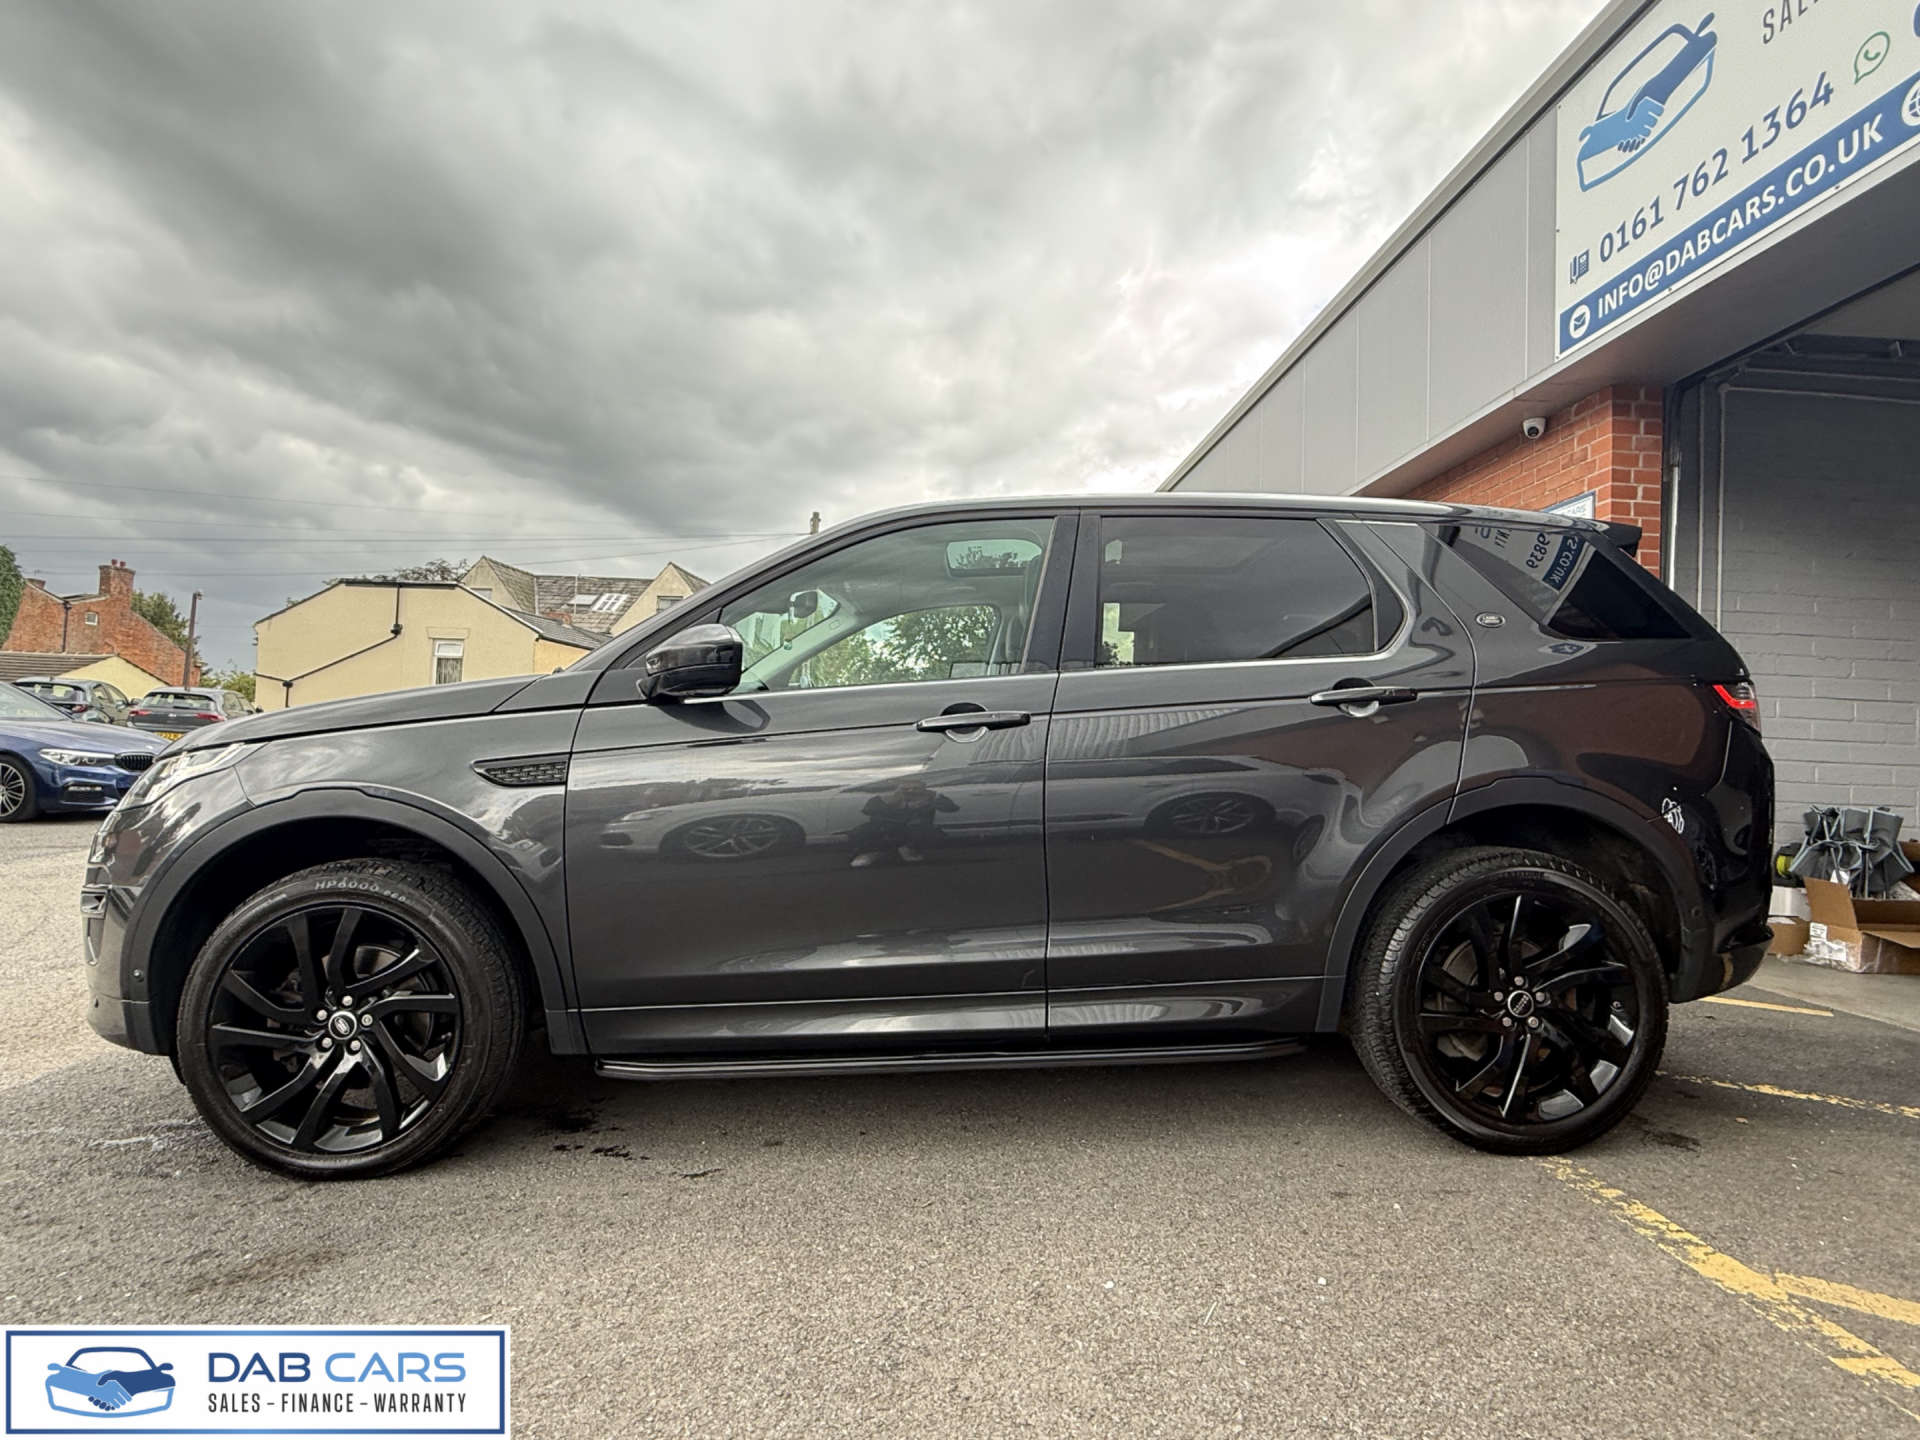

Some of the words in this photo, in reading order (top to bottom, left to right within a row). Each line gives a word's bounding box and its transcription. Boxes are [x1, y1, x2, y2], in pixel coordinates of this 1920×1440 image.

[1762, 0, 1819, 45] SAL
[1597, 113, 1884, 319] INFO@DABCARS.CO.UK
[1599, 195, 1665, 263] 0161
[1673, 148, 1729, 211] 762
[1741, 71, 1835, 165] 1364
[314, 877, 380, 891] HP6000
